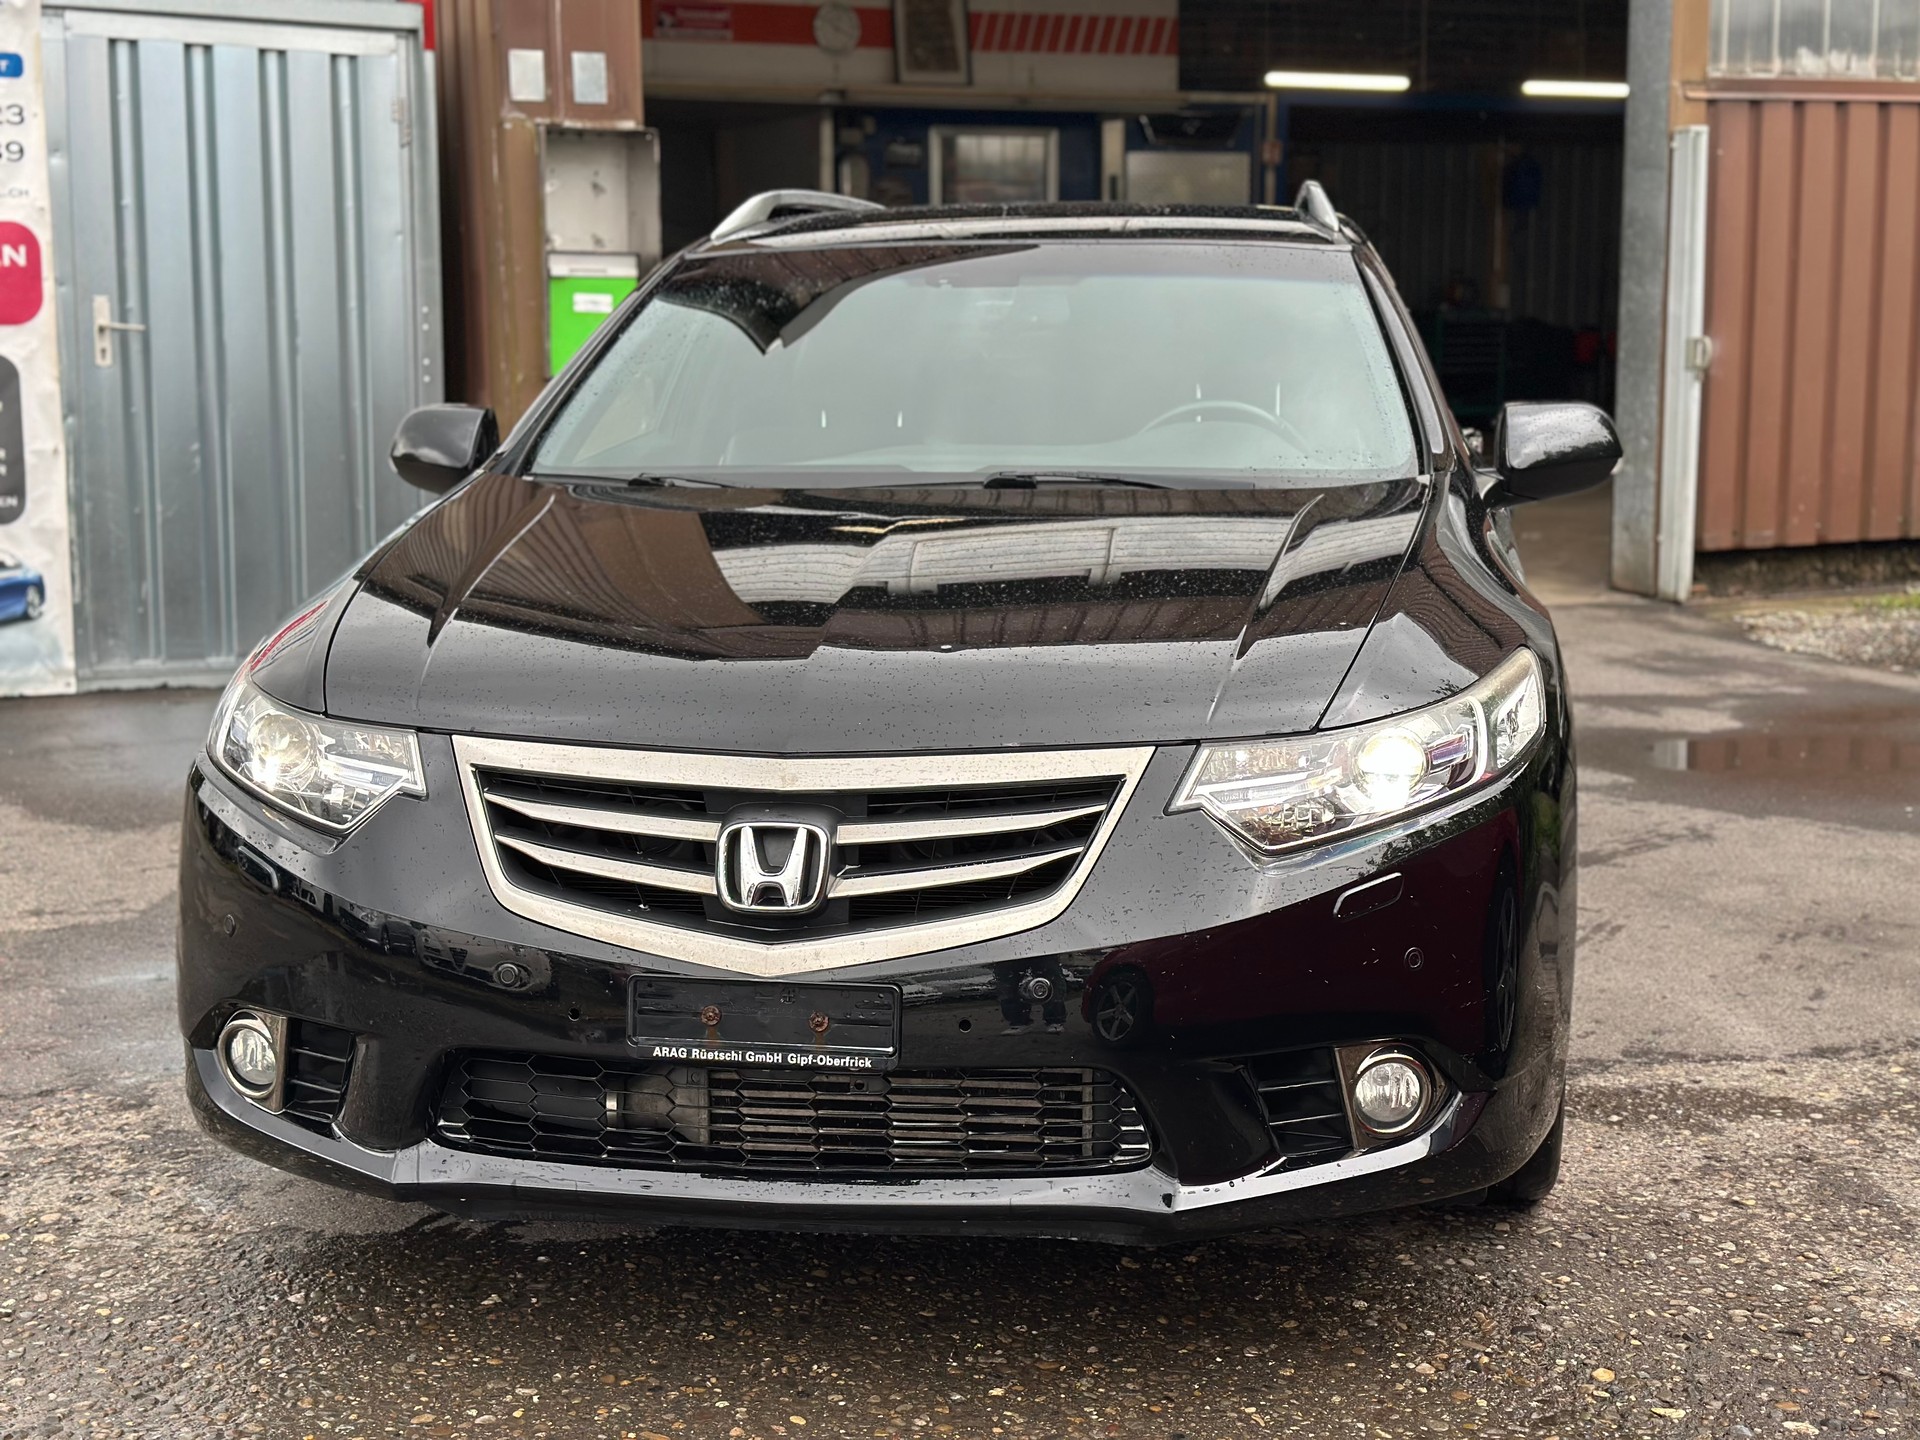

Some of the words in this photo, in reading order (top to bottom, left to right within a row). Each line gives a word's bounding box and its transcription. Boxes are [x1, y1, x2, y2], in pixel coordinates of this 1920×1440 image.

[0, 104, 25, 125] 3
[0, 140, 25, 162] 9
[0, 244, 27, 267] N
[652, 1046, 688, 1059] ARAG
[691, 1048, 743, 1061] Rüetschi
[745, 1051, 782, 1063] GmbH
[787, 1052, 872, 1068] Gipf-Oberfrick
